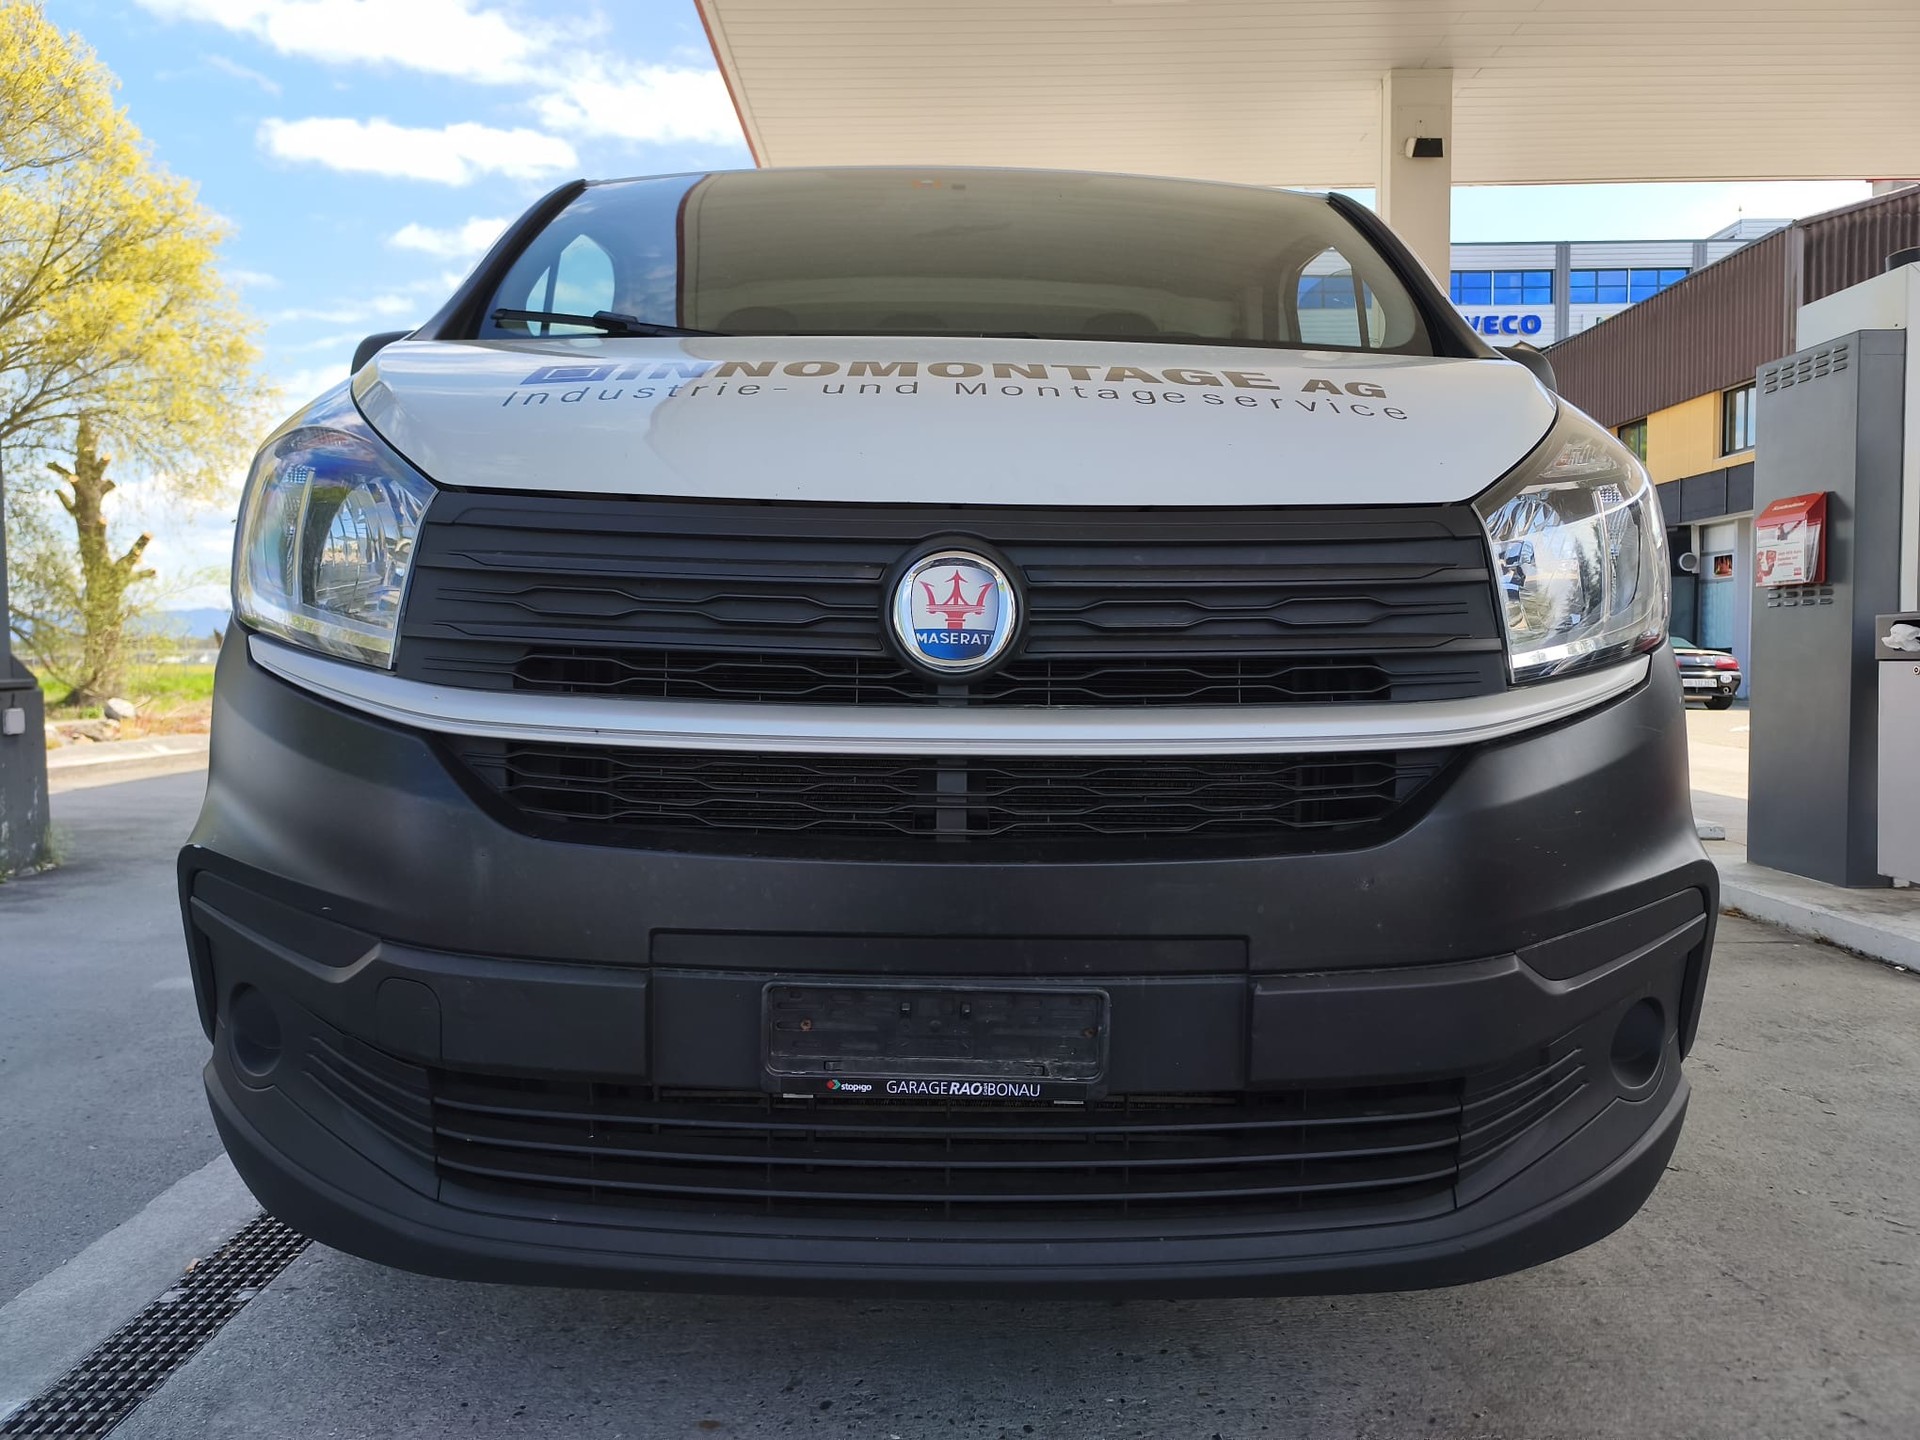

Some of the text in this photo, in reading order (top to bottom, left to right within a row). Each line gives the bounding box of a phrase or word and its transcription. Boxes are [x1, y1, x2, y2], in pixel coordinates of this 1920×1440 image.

[1464, 315, 1542, 335] VECO
[614, 361, 1388, 399] INNOMONTAGE AG
[502, 381, 1409, 421] Industrie- und Montageservice
[916, 632, 994, 645] MASERAT
